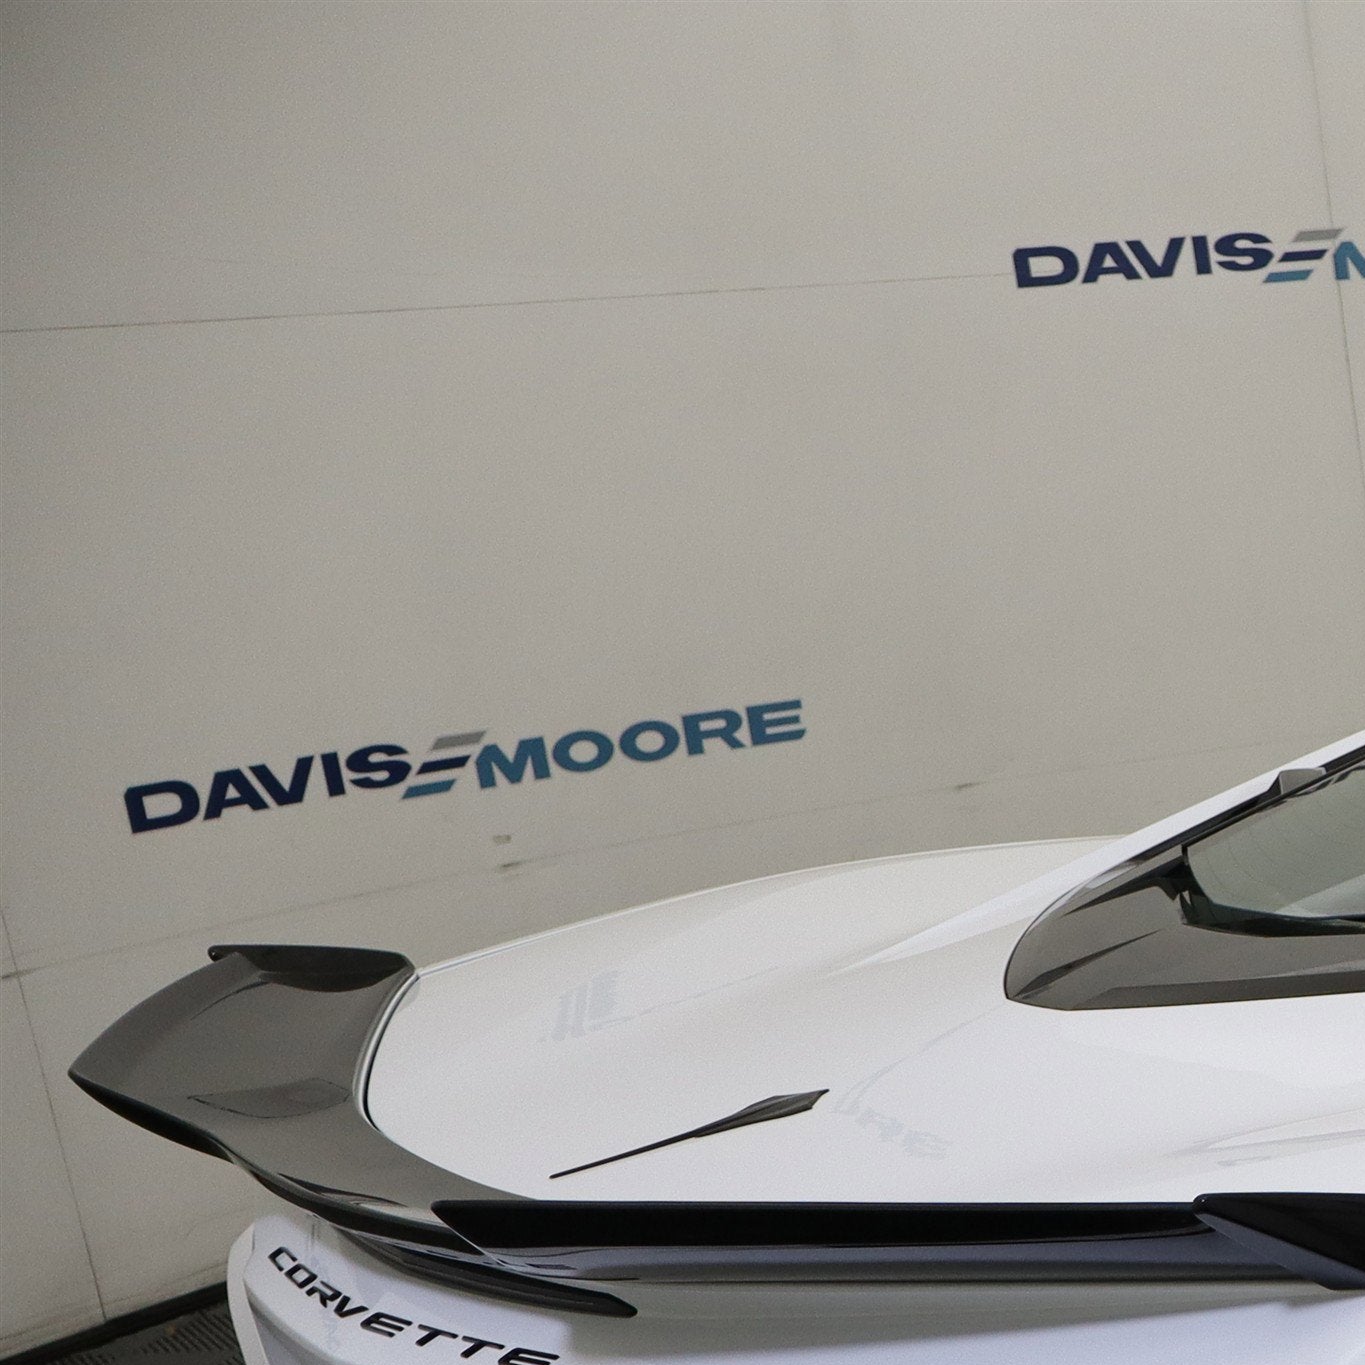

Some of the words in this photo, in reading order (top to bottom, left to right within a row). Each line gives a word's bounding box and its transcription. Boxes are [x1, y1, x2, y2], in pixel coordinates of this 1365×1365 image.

[1012, 231, 1275, 289] DAVIS
[122, 743, 413, 835] DAVIS
[474, 699, 807, 790] MOORE
